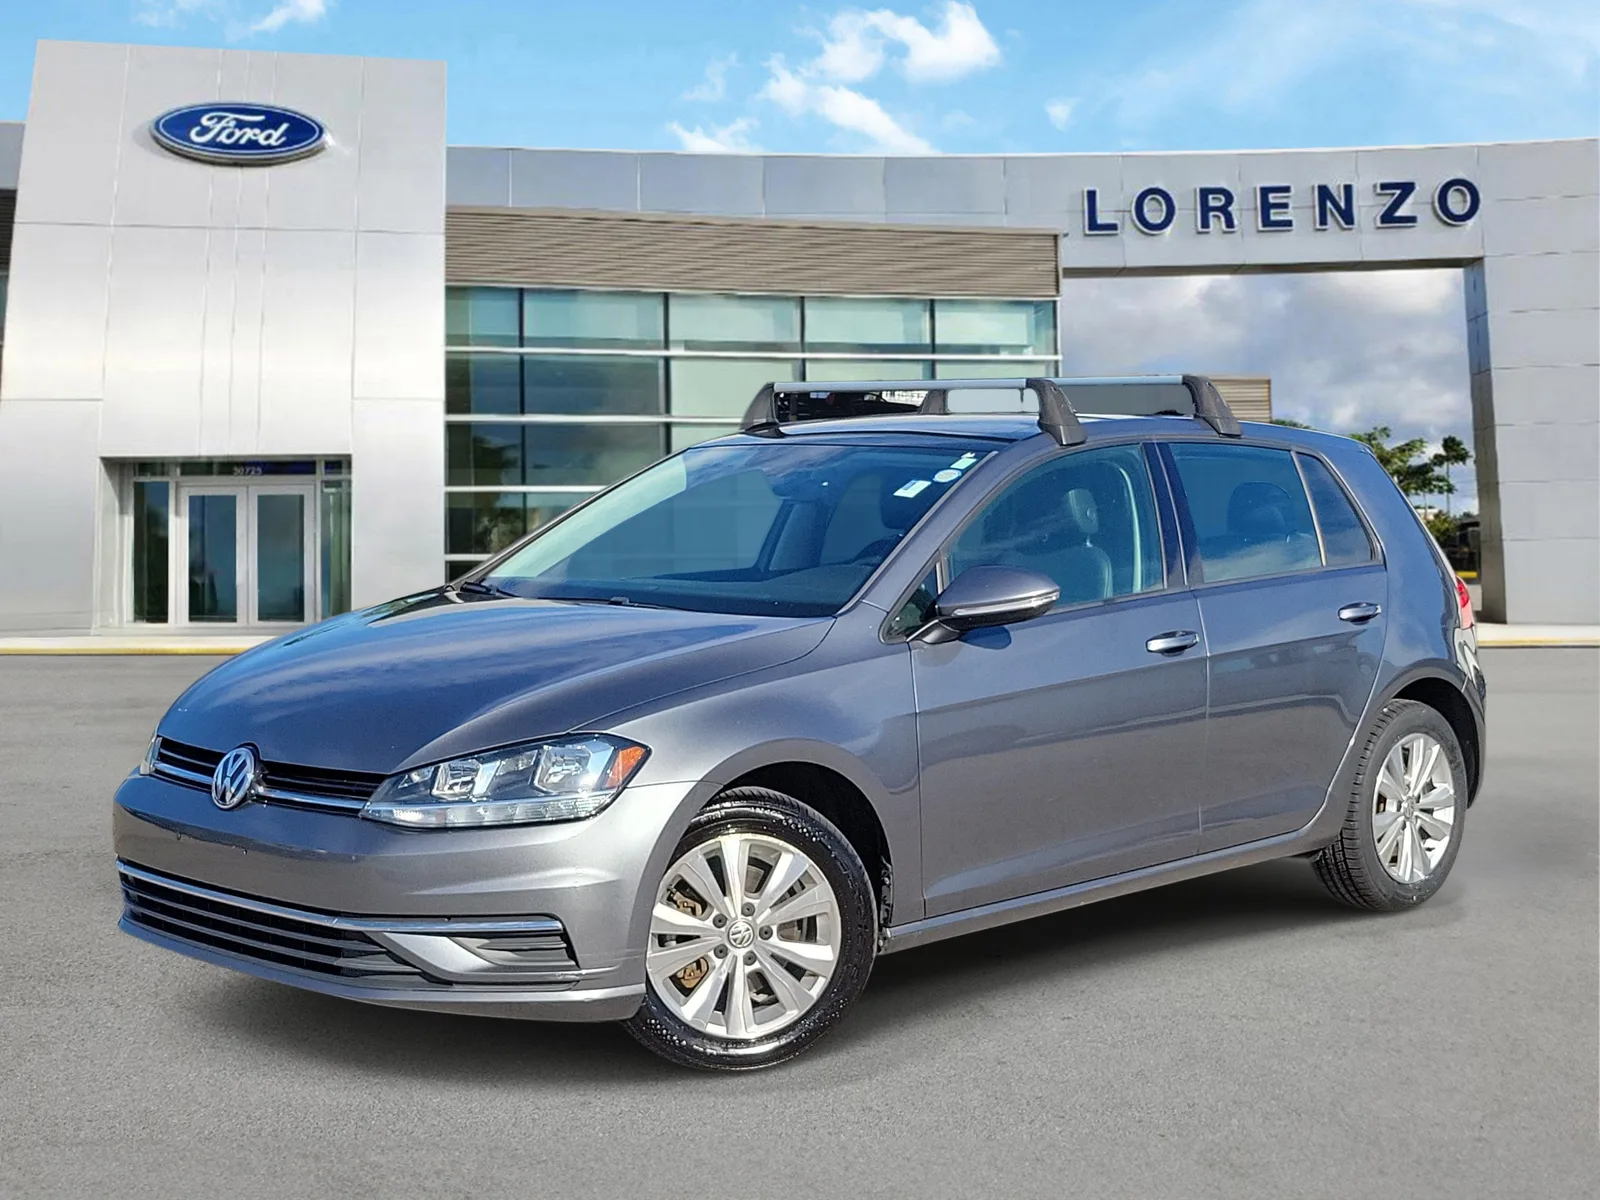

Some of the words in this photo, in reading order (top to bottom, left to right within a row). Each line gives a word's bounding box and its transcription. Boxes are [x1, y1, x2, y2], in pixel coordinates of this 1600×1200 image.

[189, 111, 290, 147] Ford
[1083, 178, 1481, 235] LORENZO
[213, 748, 254, 808] VW
